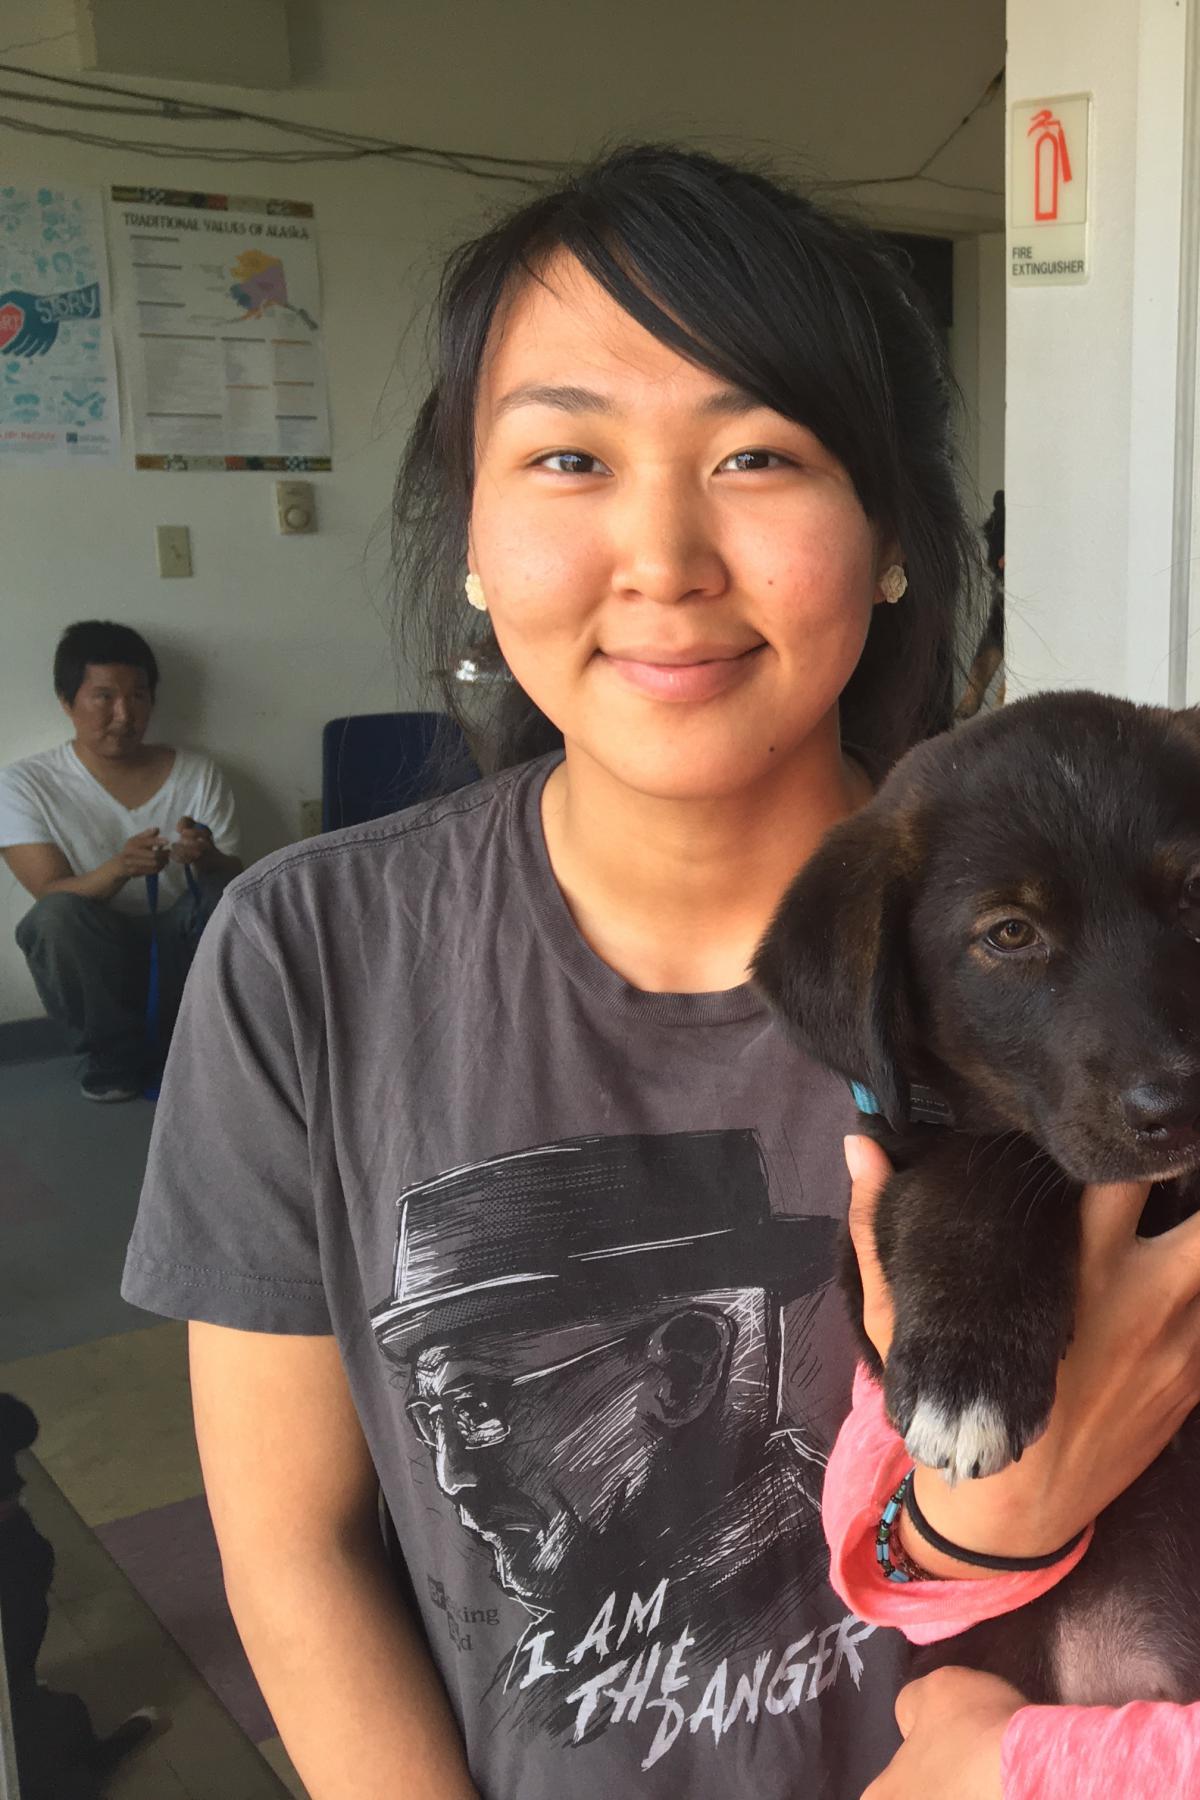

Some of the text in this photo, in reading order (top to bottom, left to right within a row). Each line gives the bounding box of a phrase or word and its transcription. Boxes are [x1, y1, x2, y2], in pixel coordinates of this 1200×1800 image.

[122, 212, 310, 240] TRADITIONAL VALUES OF ALASKA
[1012, 246, 1033, 259] FIRE
[1012, 260, 1085, 276] EXTINGUISHER
[35, 286, 96, 324] STORY
[519, 1630, 569, 1689] I
[566, 1578, 669, 1663] AM
[566, 1621, 695, 1744] THE
[641, 1613, 879, 1772] DANGER
